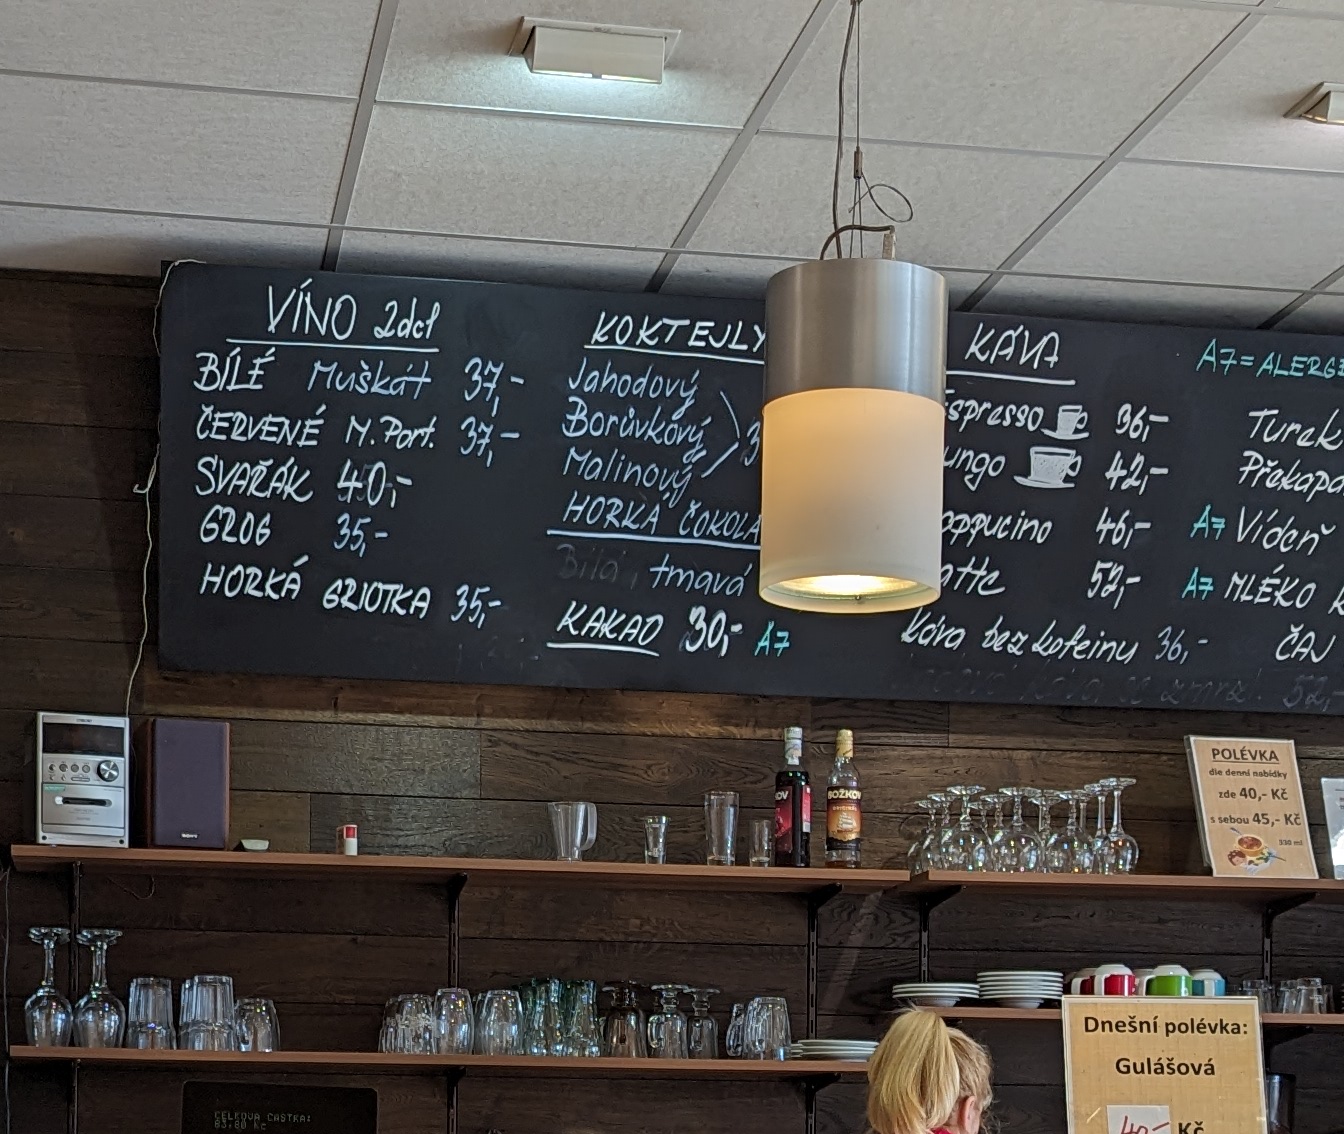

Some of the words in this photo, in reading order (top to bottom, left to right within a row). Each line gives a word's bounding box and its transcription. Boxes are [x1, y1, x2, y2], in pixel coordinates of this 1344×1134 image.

[267, 279, 357, 341] VÍNO
[373, 301, 439, 340] 2dcl
[591, 312, 765, 350] KOKTEJLY
[965, 323, 1059, 365] KÁVA
[194, 347, 276, 391] BÍLÉ
[308, 359, 432, 399] Muškát
[464, 357, 525, 416] 37,-
[568, 357, 699, 420] Jahodový
[196, 404, 327, 448] ČERVENÉ
[461, 416, 520, 467] 37,-
[561, 396, 714, 464] Borůvkový
[1115, 404, 1169, 442] 36,-
[1249, 409, 1343, 450] Turek
[195, 454, 314, 500] SVAŘÁK
[337, 465, 413, 508] 40,-
[562, 451, 694, 507] Malinový
[943, 446, 1006, 490] ungo
[1105, 452, 1169, 492] 42,-
[201, 512, 270, 546] GROG
[334, 513, 389, 557] 35,-
[563, 490, 670, 535] HORKÁ
[1095, 511, 1151, 549] 46,-
[1191, 504, 1226, 539] A7
[1235, 505, 1336, 556] Vídeň
[201, 554, 309, 599] HORKÁ
[323, 581, 431, 619] GRIOTKA
[451, 583, 501, 628] 35,-
[650, 554, 753, 596] tmavá
[940, 556, 1005, 596] atte
[1087, 561, 1141, 608] 52,-
[1182, 567, 1215, 599] A7
[1225, 563, 1313, 610] MLÉKO
[556, 601, 664, 646] KAKAO
[685, 606, 743, 657] 30,-
[754, 621, 790, 656] A7
[902, 607, 966, 650] Káva
[982, 616, 1029, 656] bez
[1032, 615, 1139, 664] kofeinu
[1156, 627, 1208, 667] 36,-
[1275, 624, 1338, 664] ČAJ
[1212, 746, 1279, 761] POLÉVKA
[1225, 768, 1251, 777] denní
[1253, 770, 1287, 780] nabídky
[828, 789, 862, 800] BOŽKOV
[1219, 791, 1236, 799] zde
[1240, 788, 1267, 801] 40,-
[1271, 788, 1289, 800] Kč
[1218, 815, 1250, 825] sebou
[1252, 813, 1280, 826] 45,-
[1284, 813, 1302, 825] Kč
[1084, 1016, 1158, 1034] Dnešní
[1165, 1018, 1248, 1037] polévka:
[1116, 1057, 1216, 1076] Gulášová
